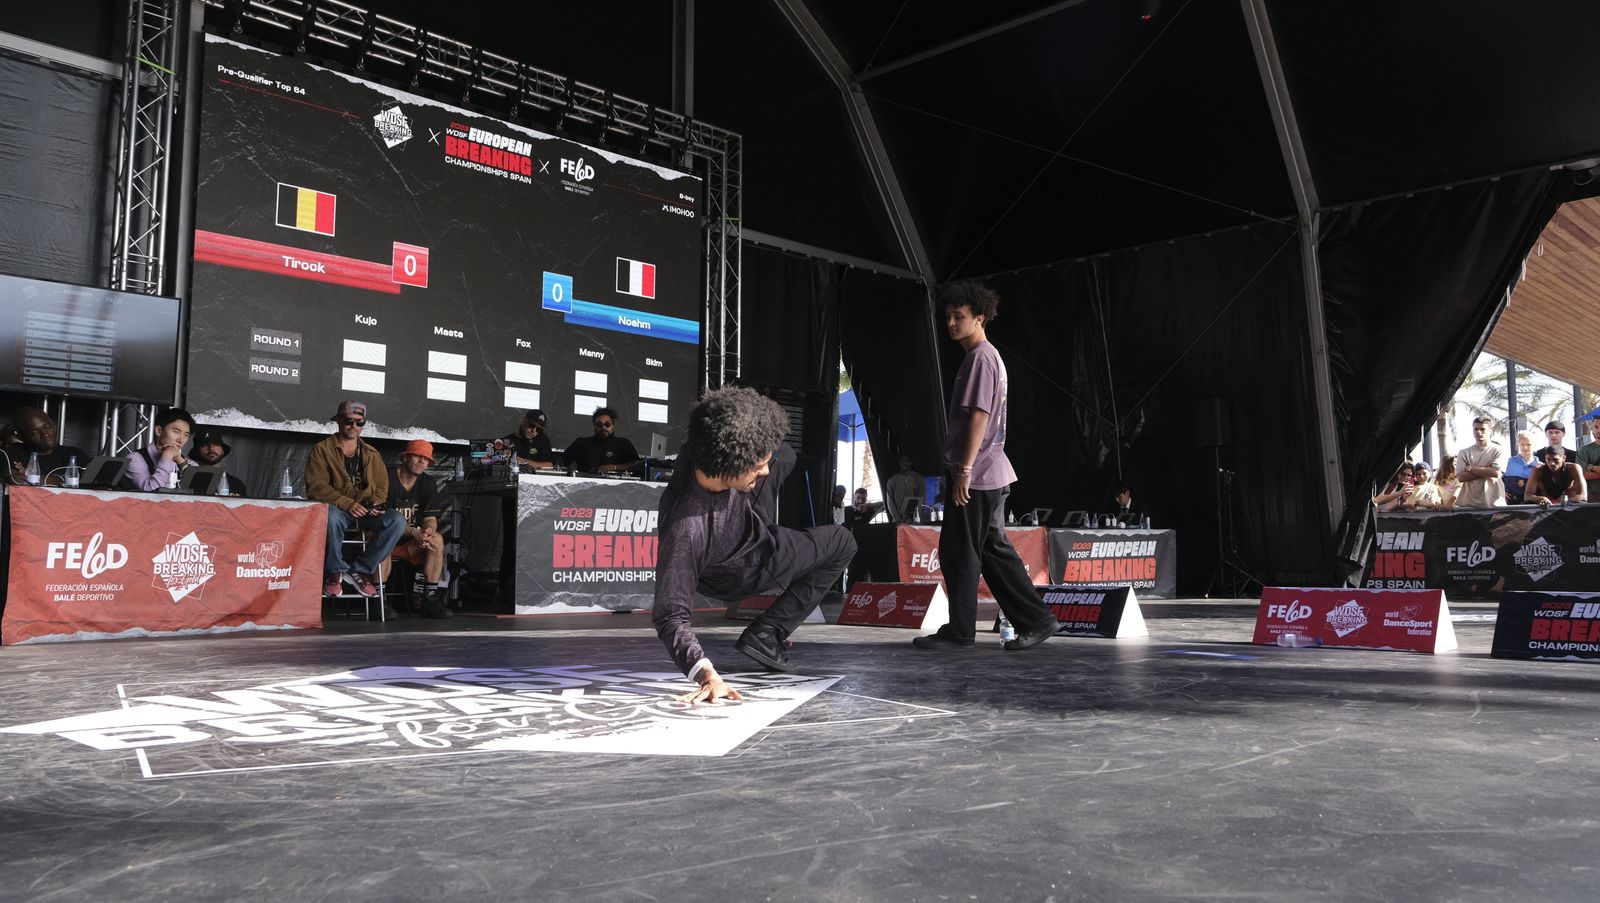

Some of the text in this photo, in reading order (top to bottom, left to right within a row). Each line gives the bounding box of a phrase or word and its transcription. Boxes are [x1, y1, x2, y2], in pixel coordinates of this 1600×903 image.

[275, 80, 292, 92] Top
[445, 127, 533, 157] WDSF EUROPEAN
[445, 135, 532, 177] BREAKING
[444, 155, 532, 184] CHAMPIONSHIPS SPAIN
[404, 255, 417, 276] 0
[552, 283, 563, 303] 0
[253, 334, 299, 348] ROUND 1
[516, 338, 532, 348] Fox
[251, 364, 299, 377] ROUND 2
[560, 507, 593, 518] 2023
[553, 508, 659, 533] WDSF EUROP
[552, 533, 659, 568] BREAKI
[1068, 540, 1157, 559] WDSF EUROPEAN
[1072, 542, 1092, 550] 2023
[1521, 544, 1556, 557] WDSF
[1579, 545, 1595, 553] world
[165, 543, 209, 563] WDSF
[237, 551, 255, 563] world
[1514, 556, 1563, 565] BREAKING
[153, 562, 215, 576] BREAKING
[236, 565, 292, 579] DanceSport
[1063, 557, 1157, 582] BREAKING
[45, 582, 124, 592] FEDERACIÓN ESPAÑOLA
[1133, 580, 1156, 589] SPAIN
[1387, 580, 1425, 589] SPAIN
[54, 593, 115, 602] BAILE DEPORTIVO
[1042, 592, 1106, 605] EUROPEAN
[1335, 606, 1365, 617] WDSF
[1534, 609, 1569, 617] WDSF
[1326, 616, 1368, 625] BREAKING
[1383, 618, 1433, 628] DanceSport
[1530, 617, 1600, 642] BREA
[1528, 641, 1600, 652] CHAMPION
[128, 665, 641, 715] WDSF
